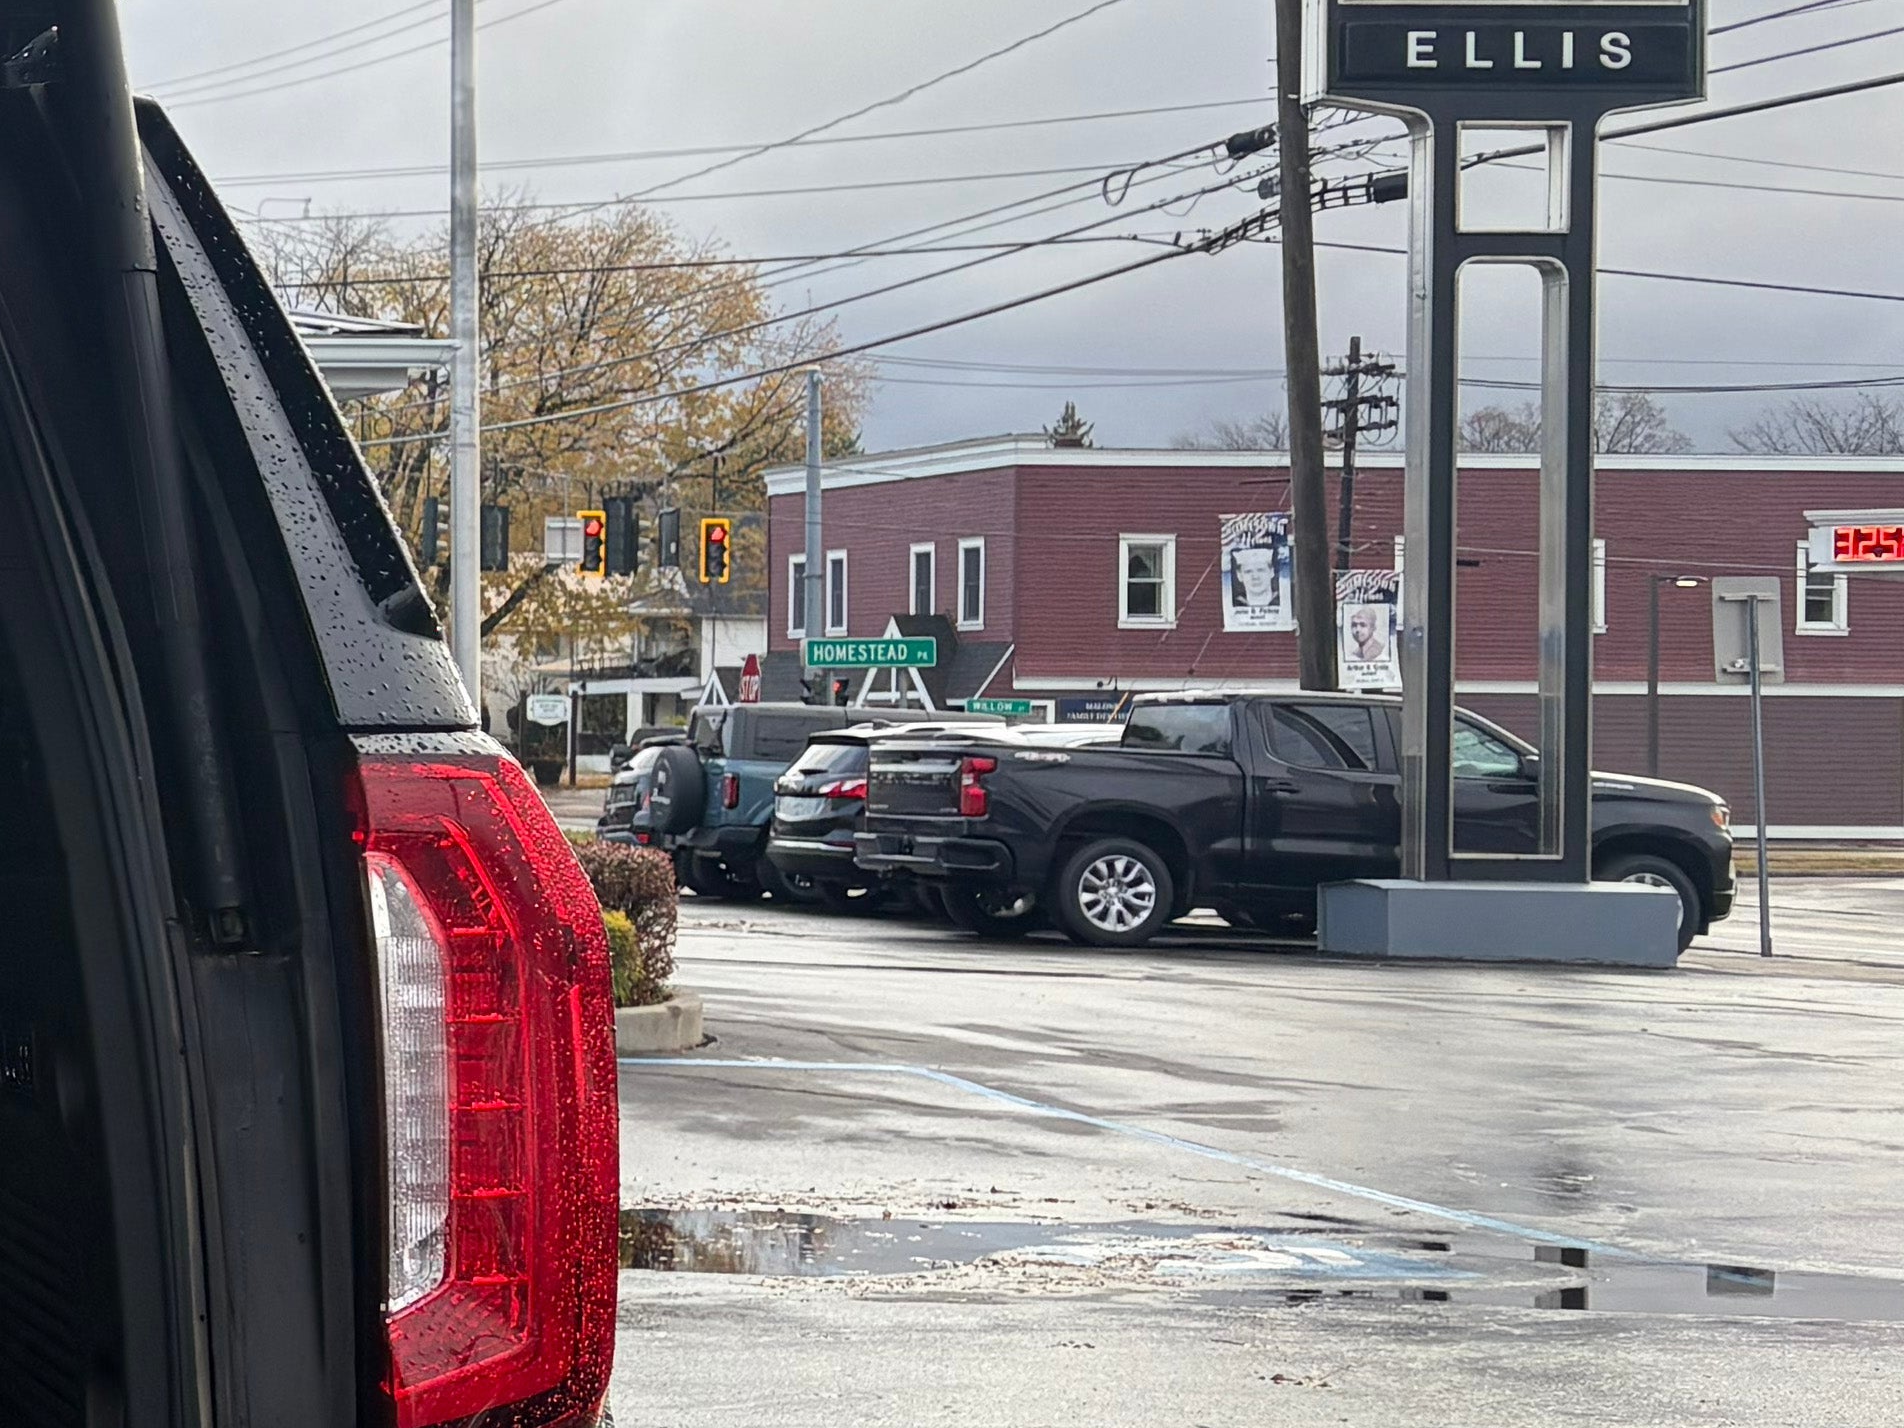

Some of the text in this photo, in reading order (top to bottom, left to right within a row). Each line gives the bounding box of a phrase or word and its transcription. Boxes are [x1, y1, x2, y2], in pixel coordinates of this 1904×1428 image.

[1407, 30, 1632, 70] ELLIS
[813, 643, 908, 662] HOMESTEAD
[972, 702, 1013, 711] WILLOW
